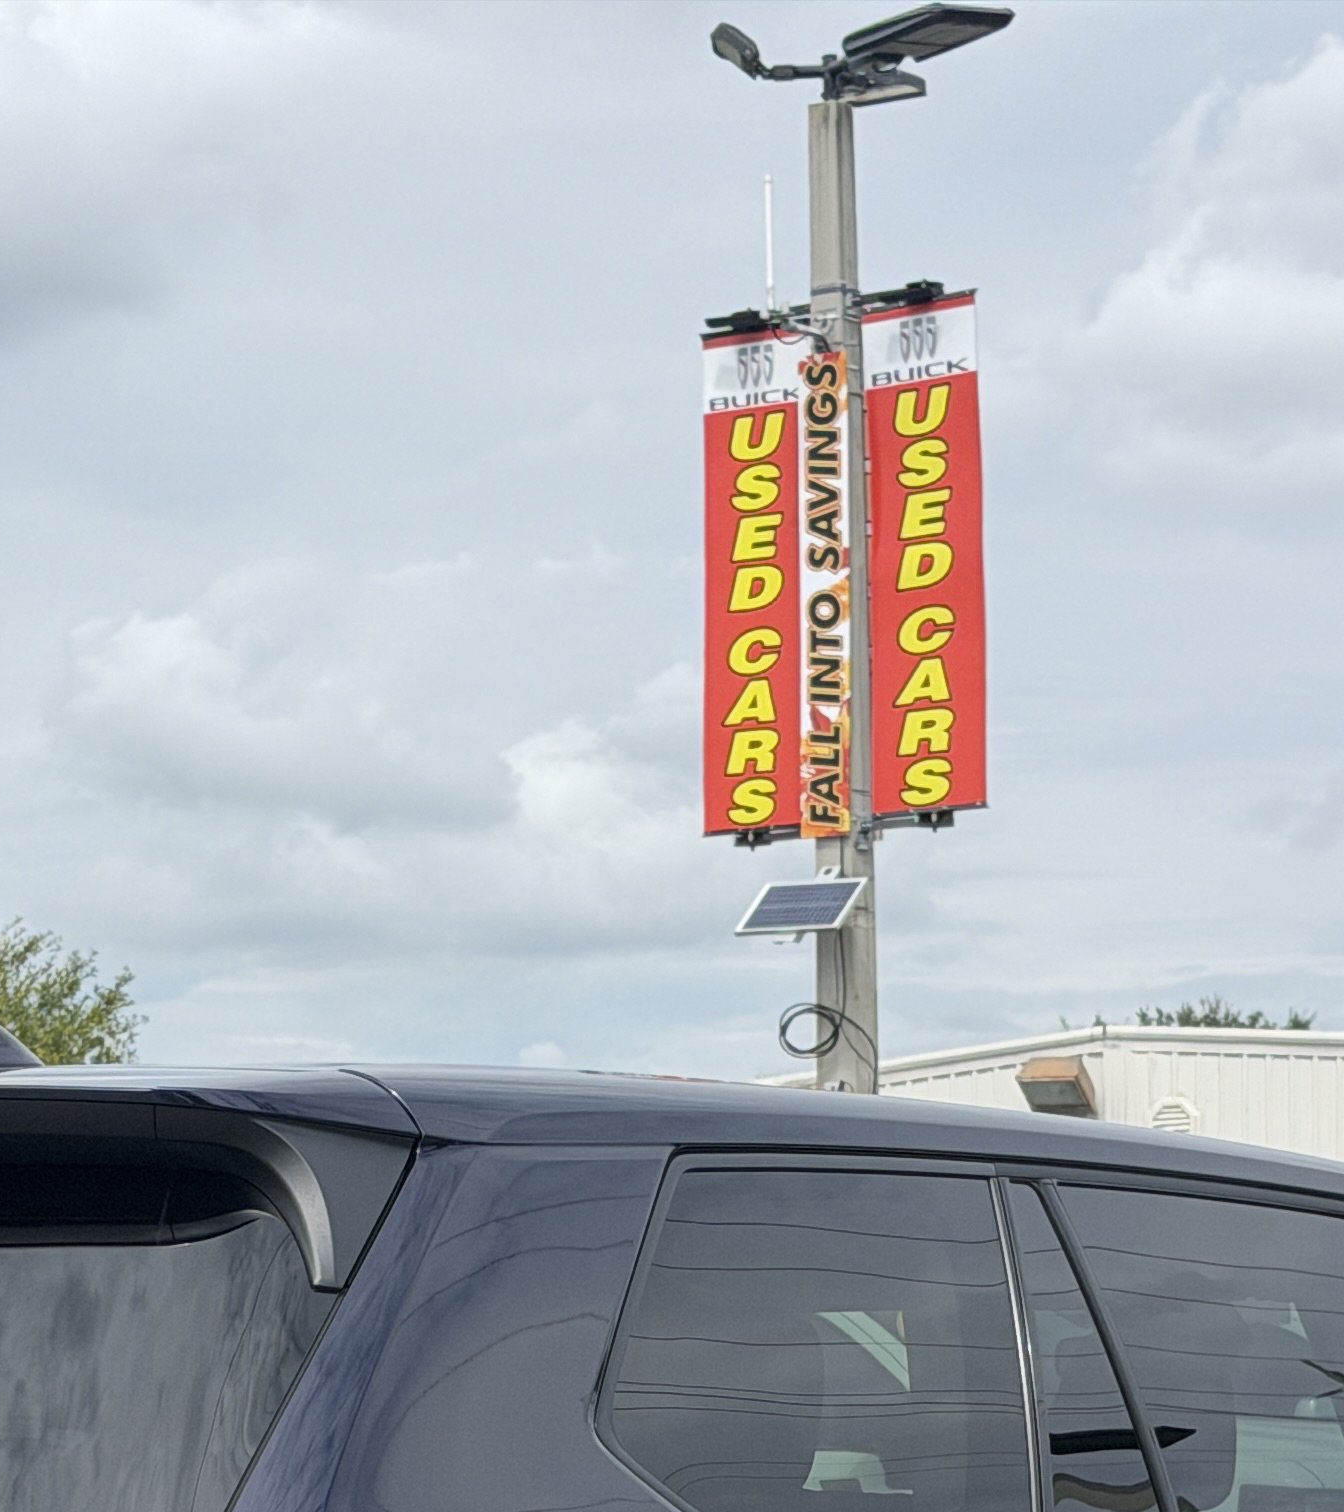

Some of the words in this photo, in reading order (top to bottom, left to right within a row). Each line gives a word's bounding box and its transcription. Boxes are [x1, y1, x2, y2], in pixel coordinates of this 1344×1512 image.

[709, 387, 799, 411] BUICK
[807, 361, 841, 572] SAVINGS
[871, 357, 968, 386] BUICK
[728, 409, 785, 613] USED
[892, 383, 955, 591] USED
[722, 626, 783, 827] CARS
[809, 589, 842, 703] INTO
[894, 605, 956, 807] CARS
[809, 724, 840, 826] FALL
